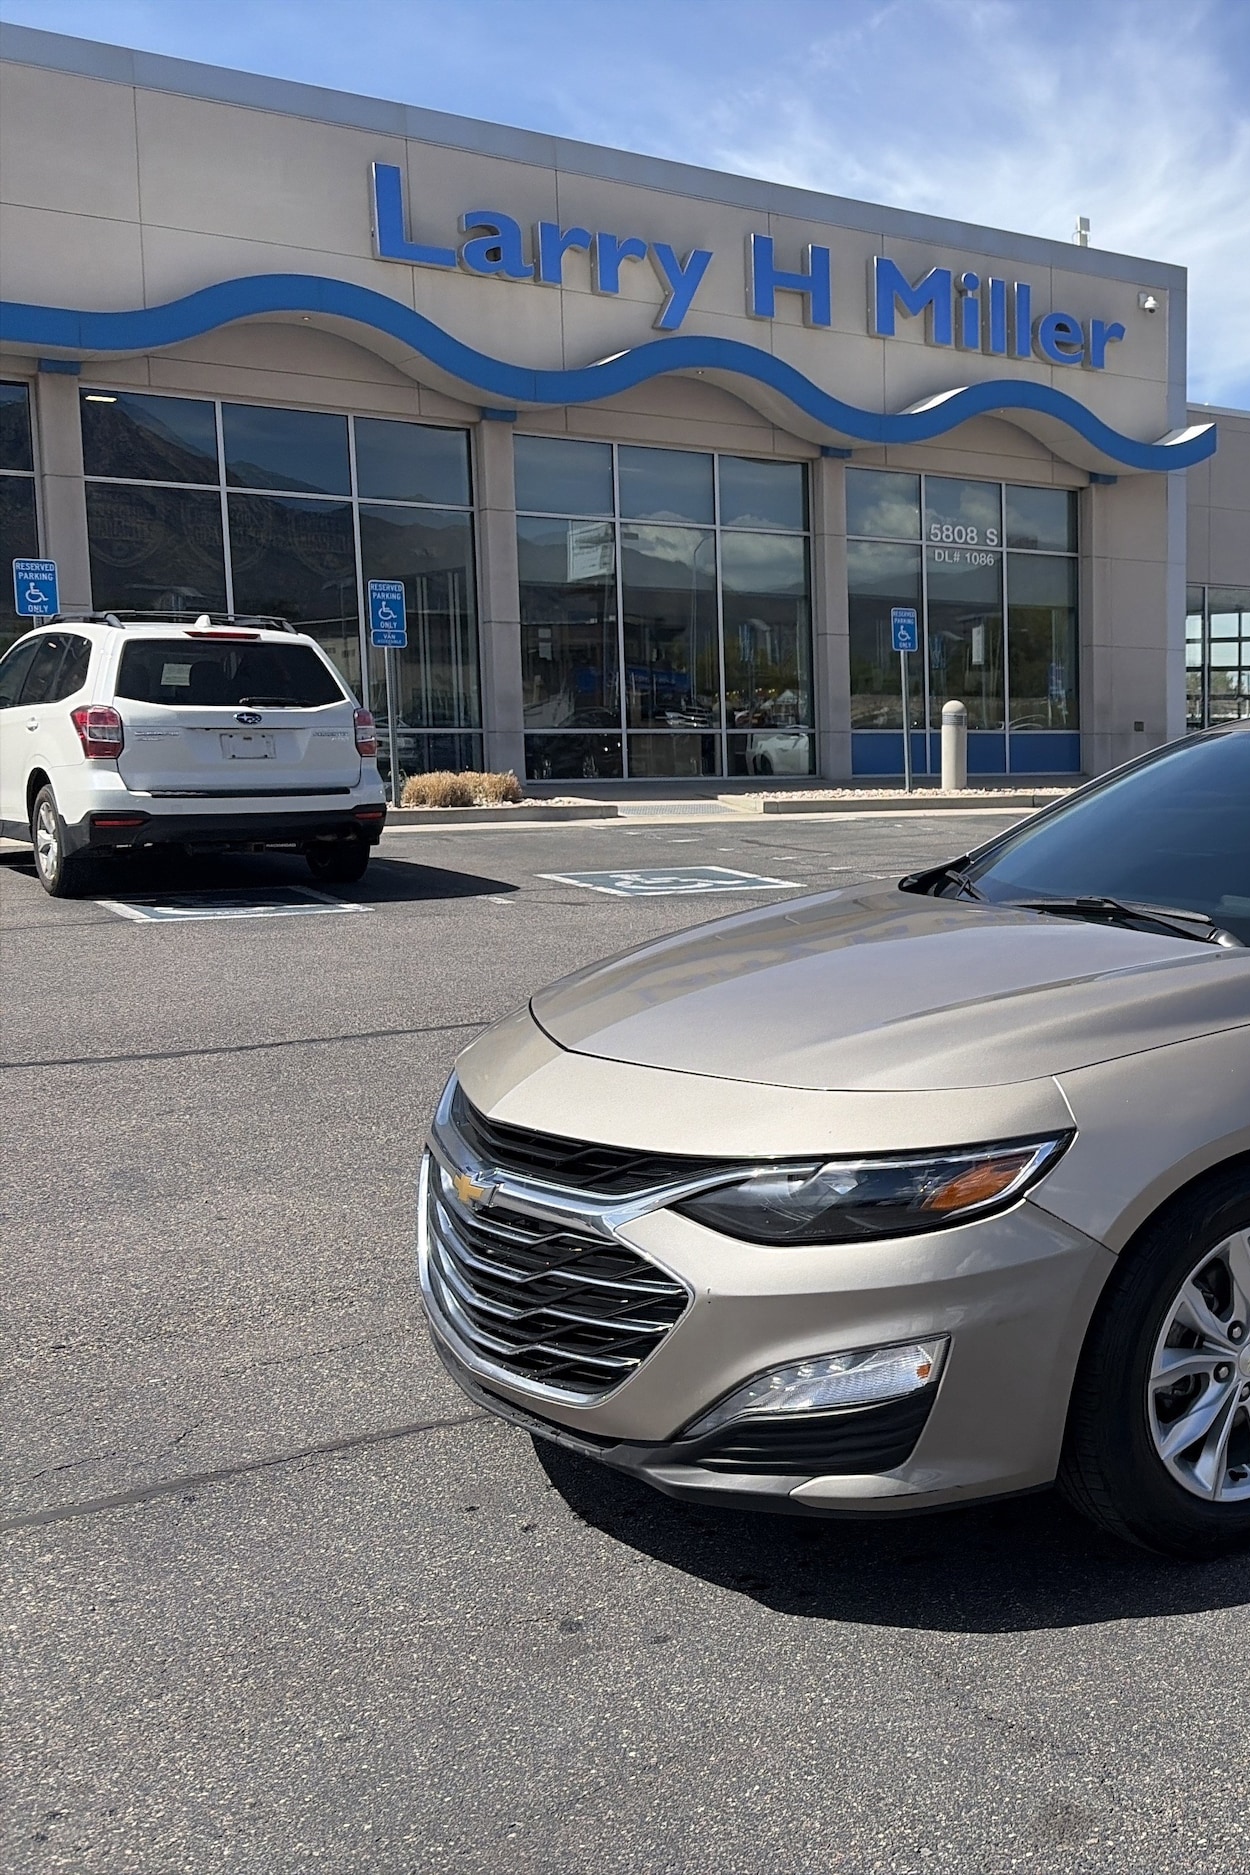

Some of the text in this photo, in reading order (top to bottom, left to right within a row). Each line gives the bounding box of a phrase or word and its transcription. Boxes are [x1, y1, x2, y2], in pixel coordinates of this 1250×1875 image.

[369, 161, 1126, 370] Larry H Miller
[930, 523, 998, 546] 5808 S
[934, 549, 994, 566] DL# 1086
[15, 562, 55, 571] RESERVED
[18, 571, 54, 581] PARKING
[370, 583, 403, 592] RESERVED
[372, 592, 401, 600] PARKING
[27, 604, 49, 613] ONLY
[380, 621, 398, 629] ONLY
